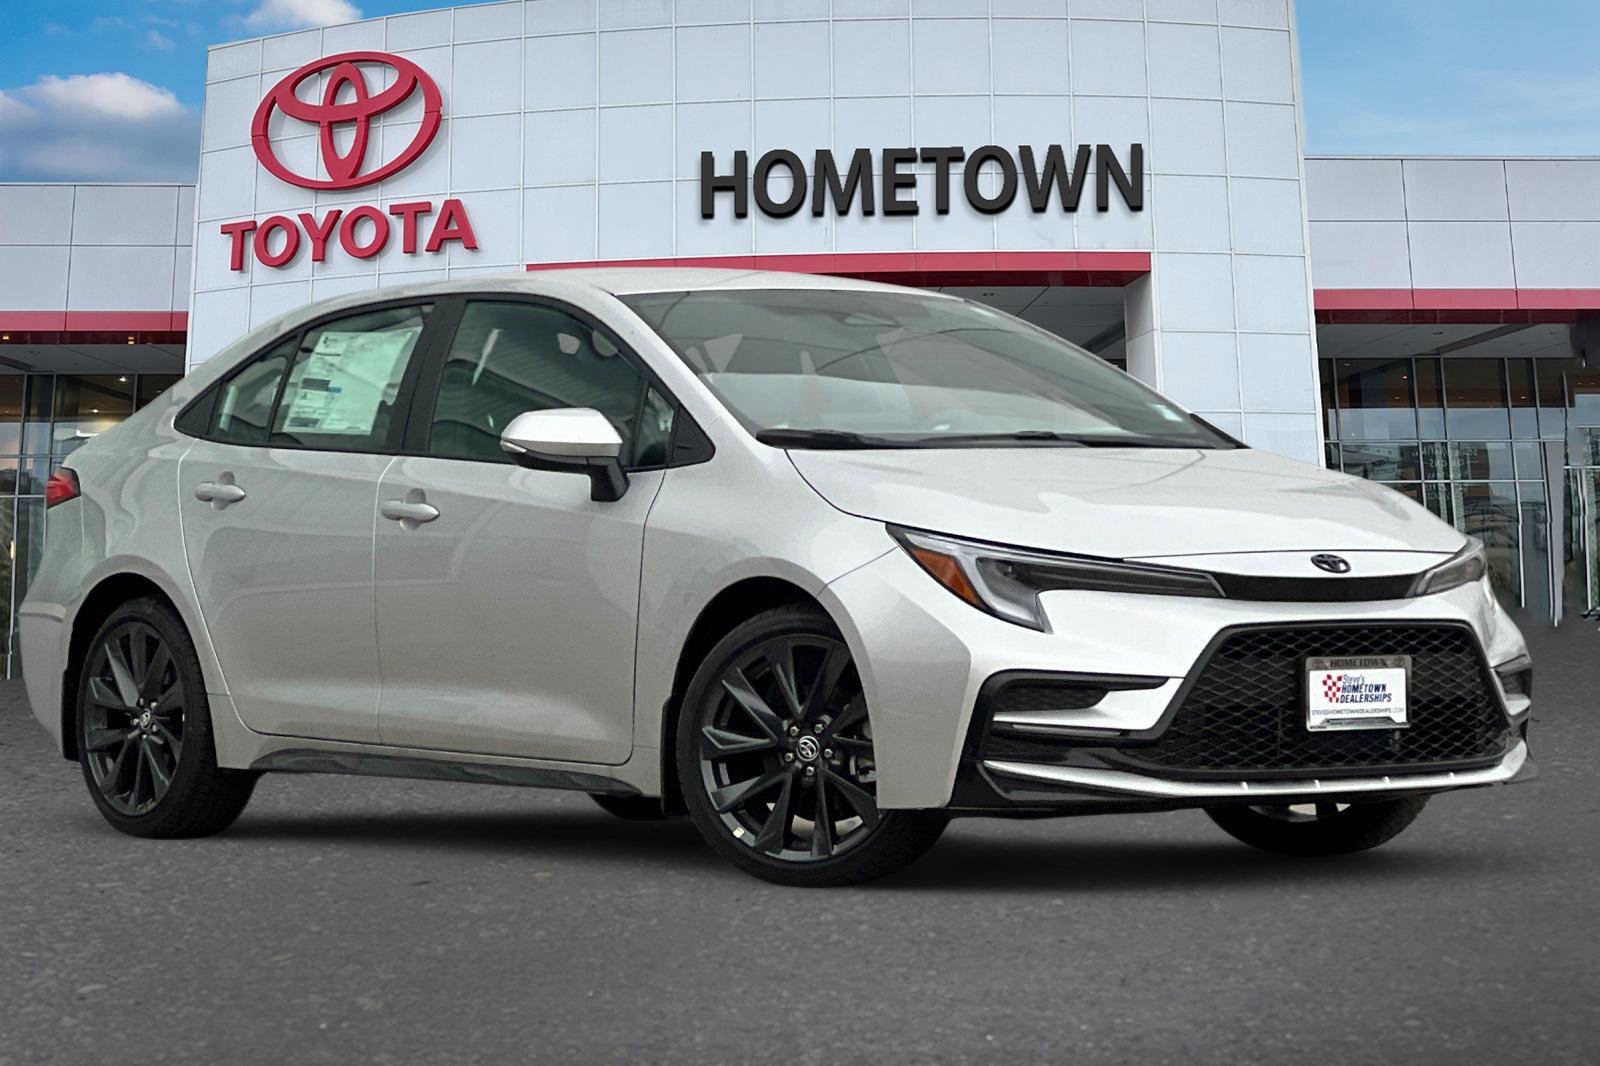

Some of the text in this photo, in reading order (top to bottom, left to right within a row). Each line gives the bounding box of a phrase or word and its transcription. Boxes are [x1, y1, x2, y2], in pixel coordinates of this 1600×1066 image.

[700, 143, 1146, 219] HOMETOWN
[220, 198, 479, 272] TOYOTA
[1330, 658, 1388, 668] HOMETOWN
[1342, 674, 1366, 685] Steve's
[1341, 683, 1387, 694] HOMETOWN
[1340, 693, 1392, 704] DEALERSHIPS
